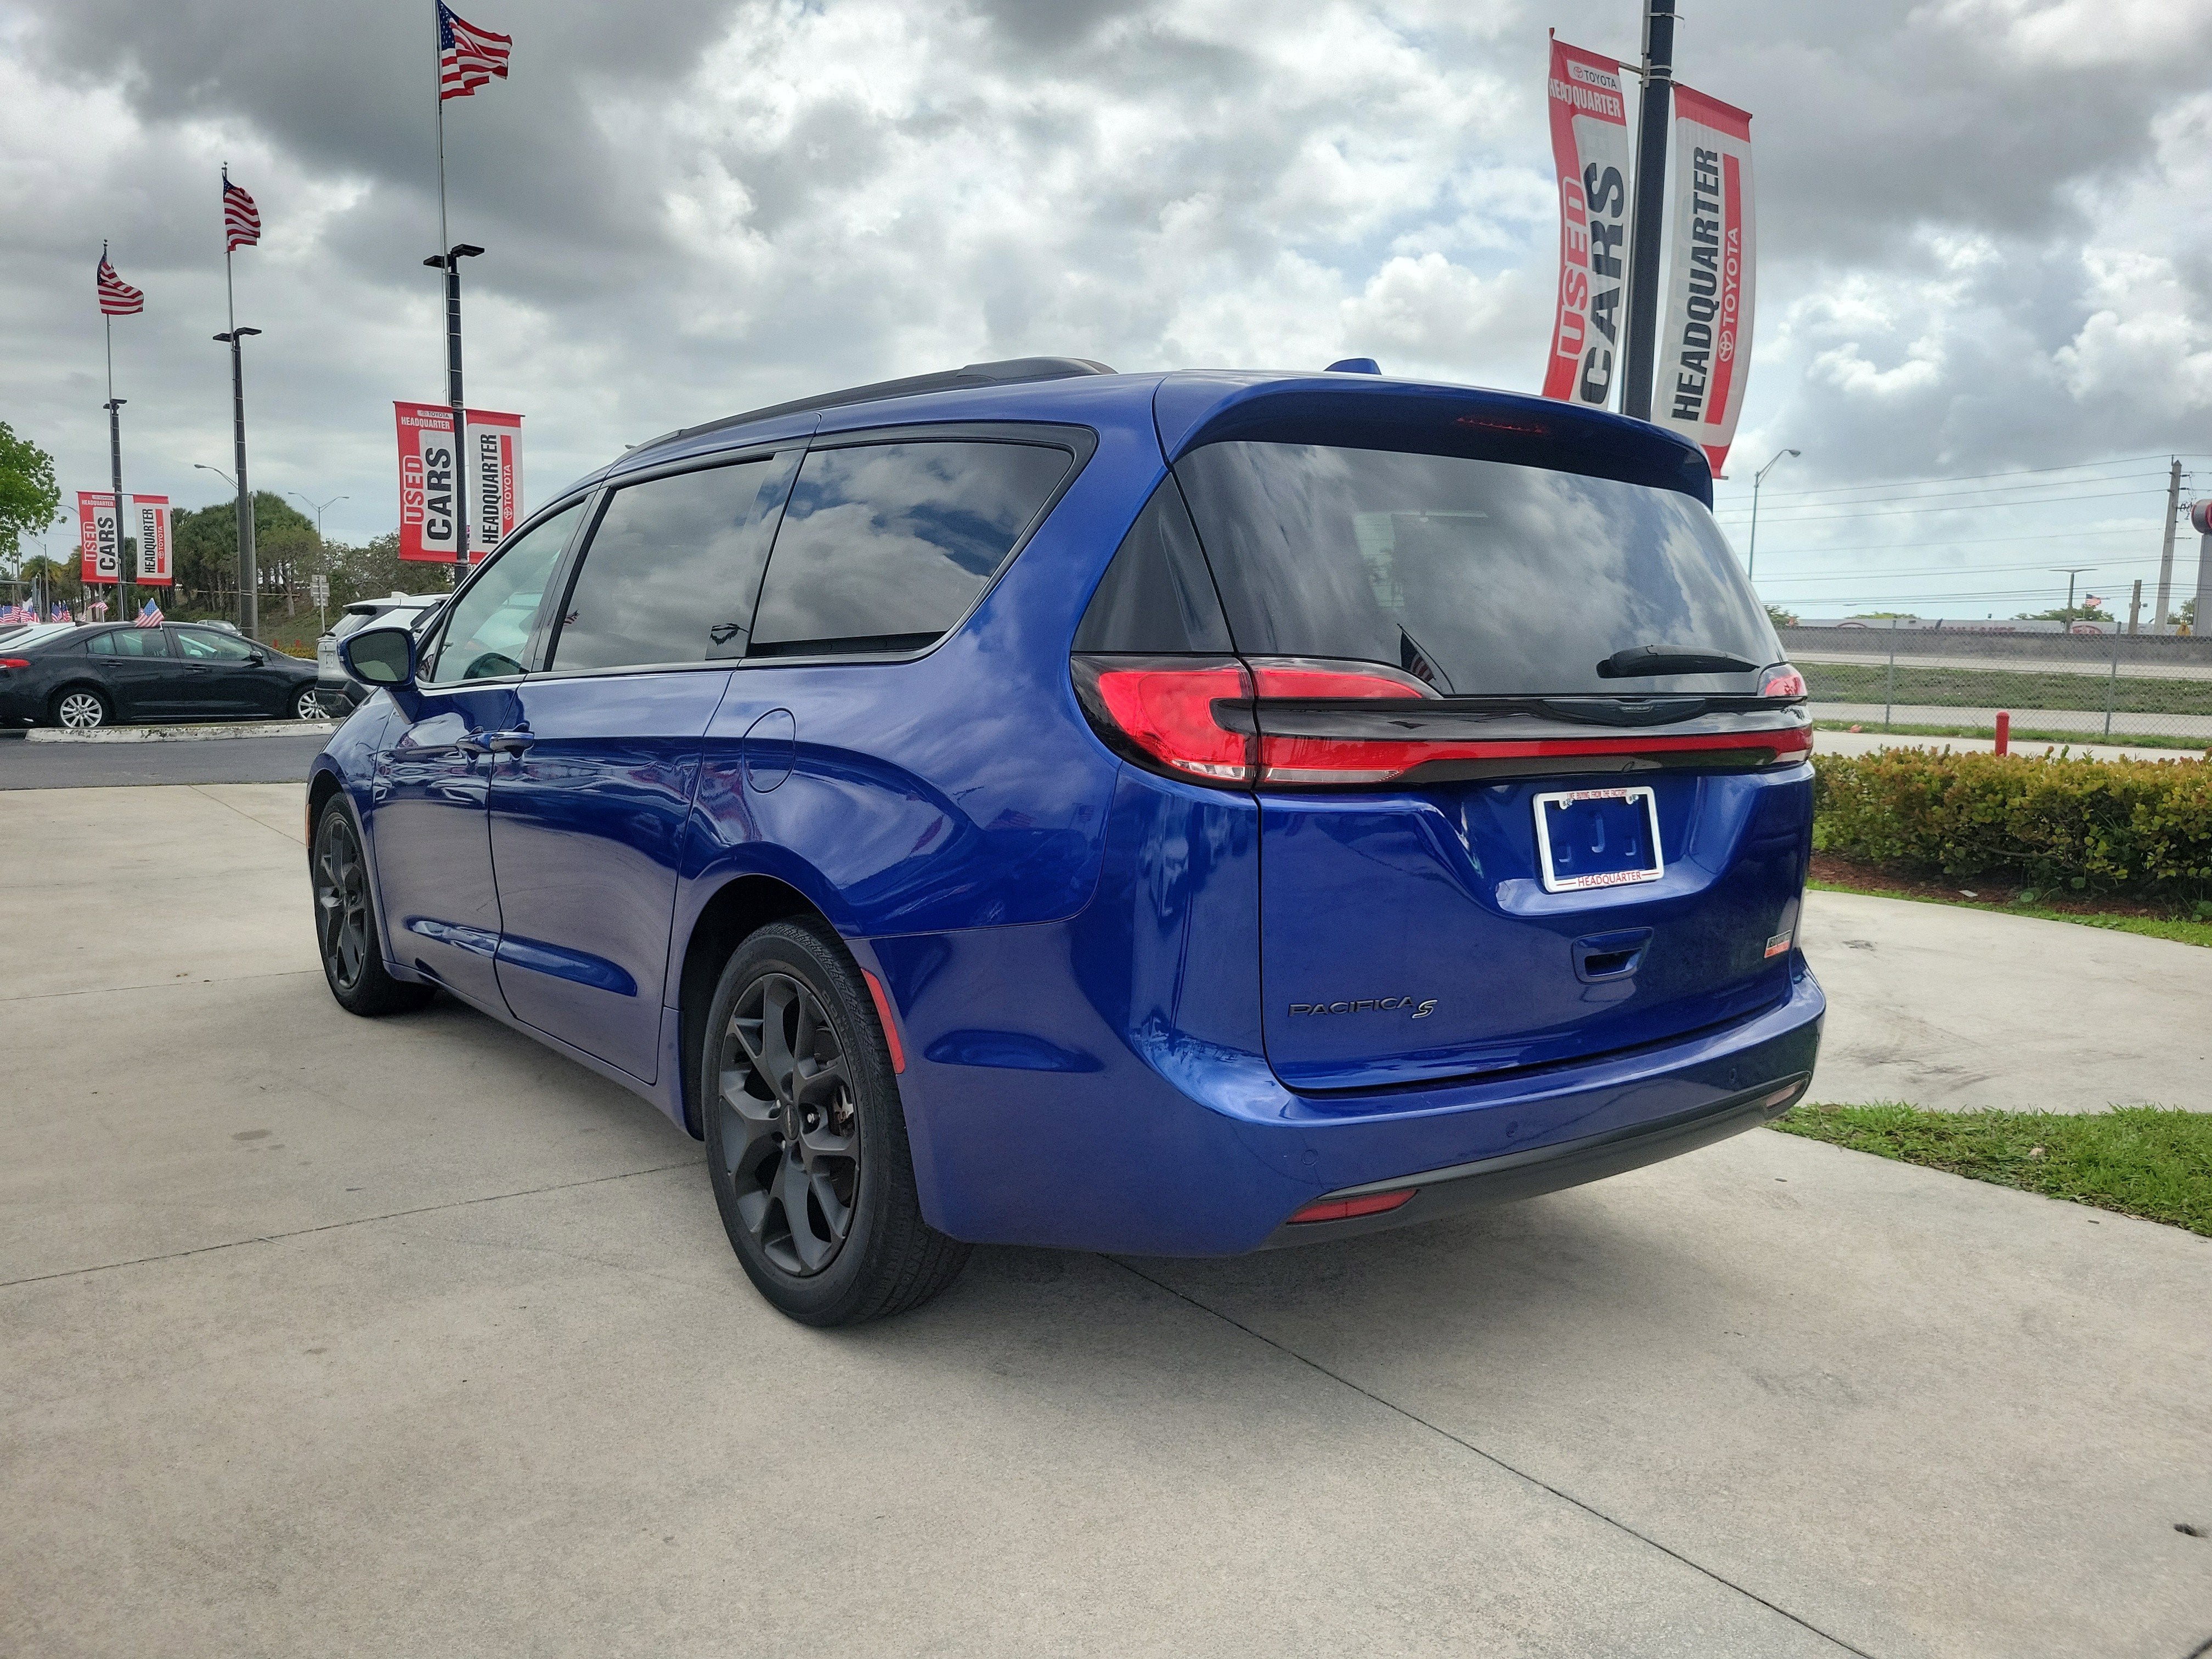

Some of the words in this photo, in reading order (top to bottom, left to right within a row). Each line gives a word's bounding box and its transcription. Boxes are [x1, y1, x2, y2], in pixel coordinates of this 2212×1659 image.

[1584, 69, 1616, 89] TOYOTA
[1556, 177, 1588, 360] USED
[1580, 162, 1624, 404] CARS
[1671, 146, 1719, 421] HEADQUARTER
[1723, 228, 1739, 328] TOYOTA
[401, 416, 450, 430] HEADQUARTER
[403, 455, 425, 524] USED
[425, 447, 452, 540] CARS
[481, 434, 501, 544] HEADQUARTER
[503, 464, 512, 505] TOYOTA
[83, 522, 98, 561] USED
[97, 516, 116, 570] CARS
[142, 509, 157, 573] HEADQUARTER
[1578, 871, 1641, 887] HEADQUARTER
[1288, 996, 1414, 1017] PACIFICA
[1412, 999, 1438, 1018] S
